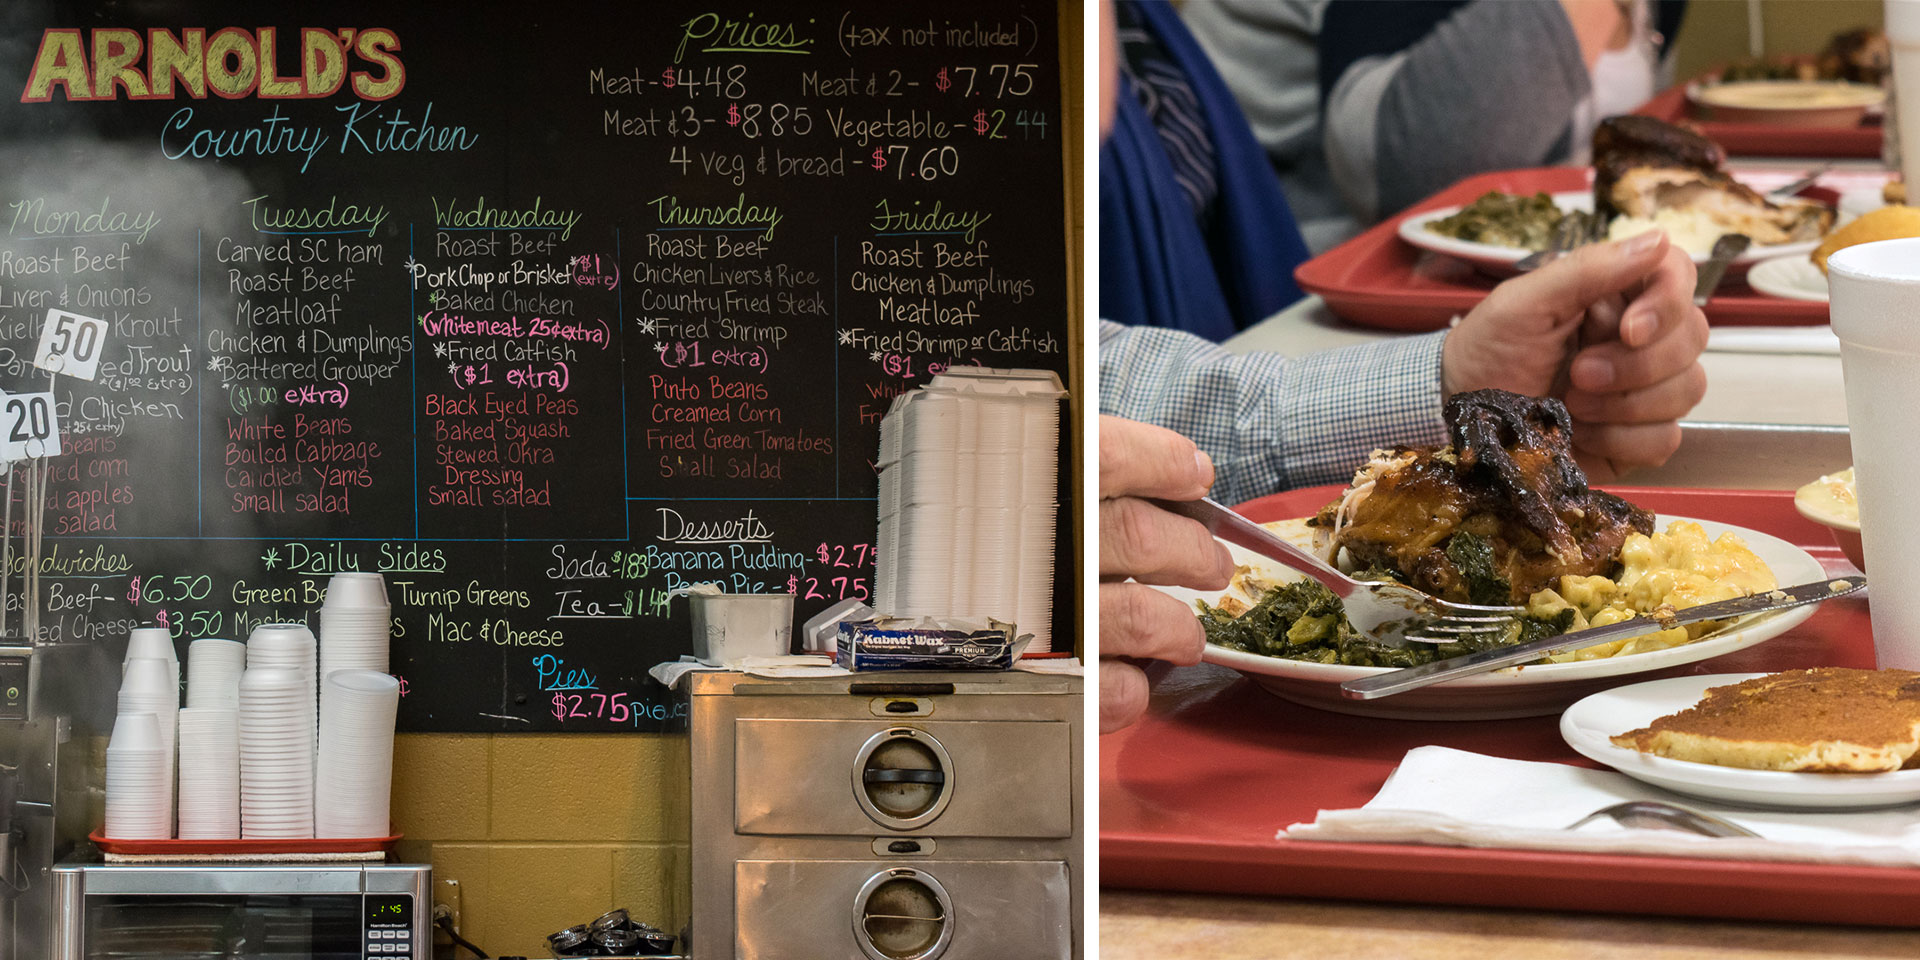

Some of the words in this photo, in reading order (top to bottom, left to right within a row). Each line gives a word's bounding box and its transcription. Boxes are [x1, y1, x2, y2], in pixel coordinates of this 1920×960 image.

[839, 11, 891, 57] (tax
[902, 19, 935, 47] not
[20, 26, 406, 102] ARNOLD'S
[662, 64, 746, 98] $4.48
[803, 71, 859, 97] Meat
[867, 71, 880, 96] &
[936, 63, 1038, 98] $7.75
[604, 110, 661, 136] Meat
[726, 102, 812, 138] $8.85
[973, 108, 1047, 140] $2.44
[162, 105, 329, 173] Country
[335, 101, 479, 154] Kitchen
[669, 146, 691, 175] 4
[700, 151, 745, 185] veg
[756, 149, 768, 174] &
[871, 145, 958, 180] $7.60
[10, 196, 161, 244] Monday
[242, 195, 390, 237] Tuesday
[432, 196, 582, 241] Wednesday
[648, 193, 783, 241] Thursday
[870, 199, 991, 244] Friday
[217, 237, 294, 264] Carved
[299, 238, 330, 263] SC
[338, 238, 383, 265] ham
[437, 232, 499, 257] Roast
[509, 232, 557, 257] Beef
[646, 233, 707, 259] Roast
[716, 235, 768, 259] Beef
[862, 240, 923, 268] Roast
[933, 240, 990, 267] Beef
[1, 248, 64, 279] Roast
[72, 243, 130, 274] Beef
[499, 272, 510, 284] or
[512, 260, 572, 285] Brisket
[633, 262, 706, 284] Chicken
[709, 263, 762, 286] Livers
[776, 264, 820, 287] Rice
[59, 284, 69, 307] &
[77, 284, 151, 307] Onions
[228, 266, 293, 295] Roast
[302, 266, 356, 292] Beef
[851, 271, 923, 295] Chicken
[939, 267, 1035, 304] Dumplings
[236, 293, 342, 329] Meatloaf
[435, 289, 494, 311] Baked
[502, 290, 574, 316] Chicken
[641, 289, 721, 323] Country
[725, 290, 770, 314] Fried
[777, 291, 829, 315] Steak
[880, 297, 980, 326] Meatloaf
[114, 307, 182, 338] Krout
[655, 317, 709, 338] Fried
[720, 318, 787, 349] Shrimp
[51, 315, 98, 363] 50
[208, 329, 287, 355] Chicken
[313, 324, 413, 364] Dumplings
[448, 339, 497, 361] Fried
[504, 339, 577, 362] Catfish
[851, 328, 903, 353] Fried
[906, 330, 967, 358] Shrimp
[971, 336, 985, 349] or
[988, 326, 1059, 353] Catfish
[127, 344, 192, 375] Trout
[221, 355, 318, 382] Battered
[322, 356, 399, 386] Grouper
[649, 374, 699, 400] Pinto
[708, 375, 768, 400] Beans
[6, 397, 50, 442] 20
[81, 395, 183, 421] Chicken
[426, 393, 478, 416] Black
[485, 392, 528, 422] Eyed
[537, 393, 579, 415] Peas
[652, 403, 730, 423] Creamed
[739, 402, 781, 423] Corn
[228, 414, 287, 441] White
[295, 413, 352, 438] Beans
[436, 419, 495, 441] Baked
[505, 418, 570, 446] Squash
[647, 427, 696, 450] Fried
[704, 427, 752, 450] Green
[754, 428, 833, 454] Tomatoes
[61, 432, 117, 456] Beans
[296, 438, 382, 471] Cabbage
[436, 440, 499, 464] Stewed
[509, 442, 554, 464] Okra
[314, 464, 373, 488] Yams
[446, 466, 523, 488] Dressing
[66, 481, 134, 515] apples
[429, 485, 483, 506] Small
[656, 508, 774, 542] Desserts
[285, 543, 359, 574] Daily
[378, 543, 447, 572] Sides
[546, 544, 608, 579] Soda
[646, 545, 723, 570] Banana
[127, 575, 211, 606] $6.50
[232, 580, 296, 604] Green
[394, 582, 461, 611] Turnip
[467, 580, 531, 608] Greens
[787, 574, 868, 601] $2.75
[428, 613, 472, 642] Mac
[493, 620, 564, 646] Cheese
[533, 654, 598, 690] Pies
[551, 692, 628, 722] $2.75
